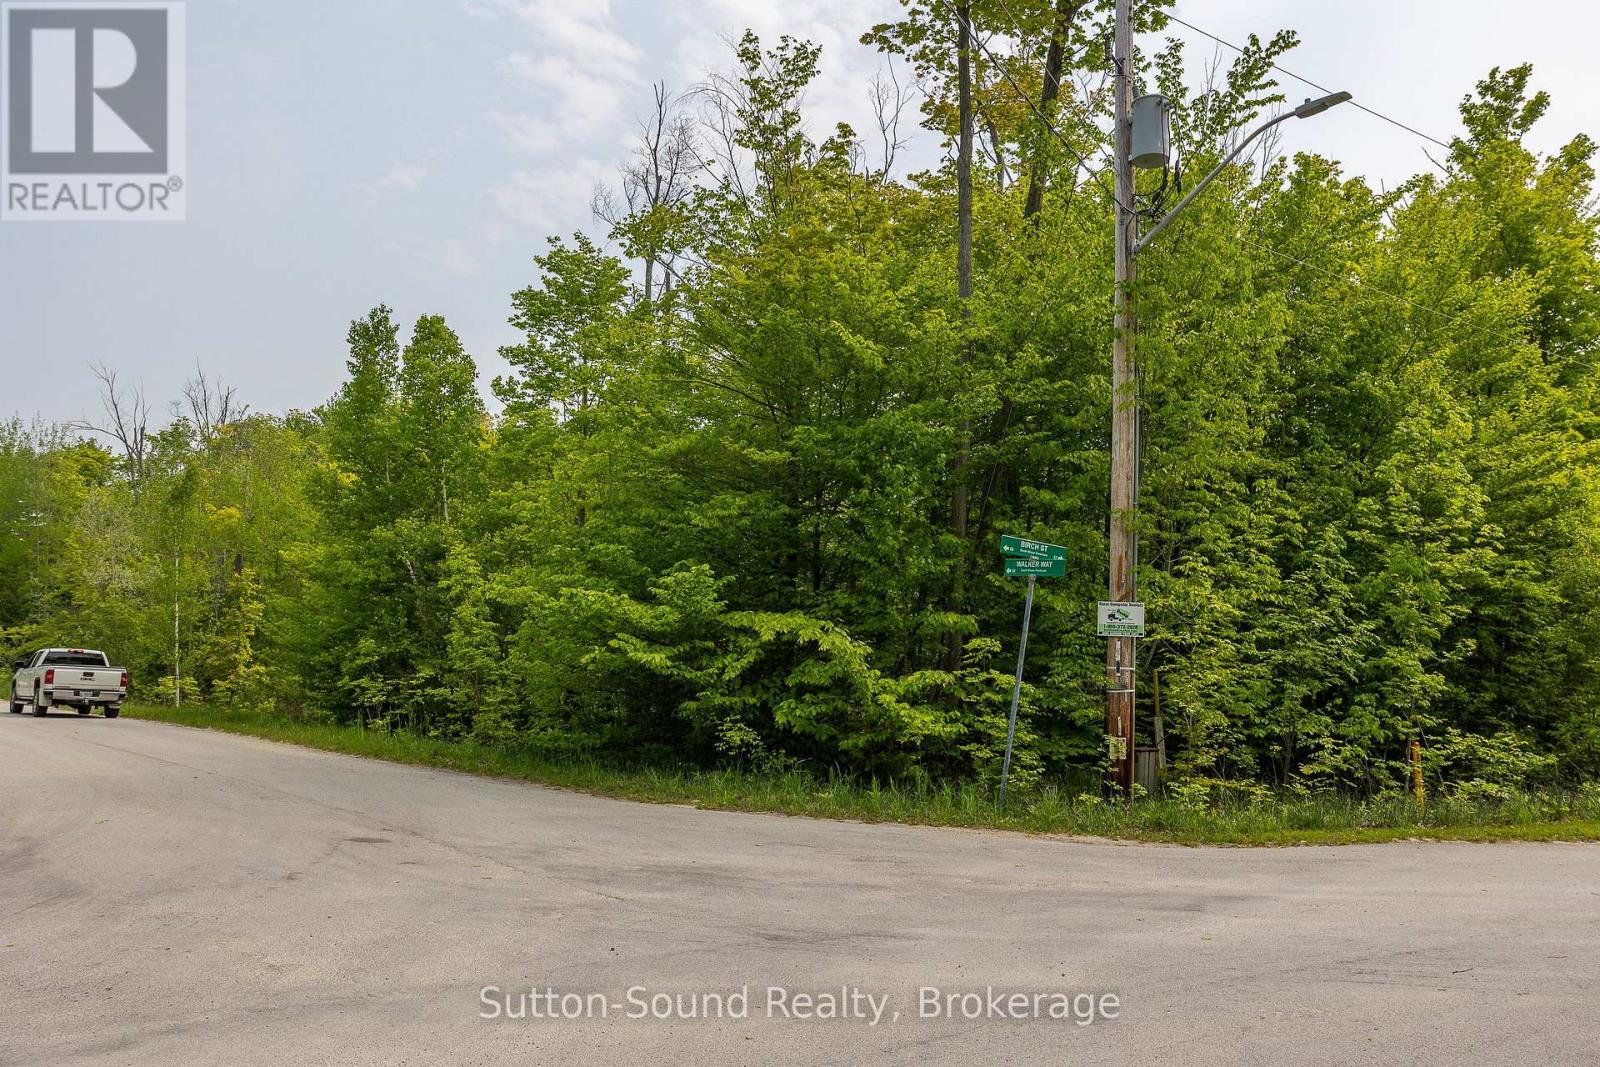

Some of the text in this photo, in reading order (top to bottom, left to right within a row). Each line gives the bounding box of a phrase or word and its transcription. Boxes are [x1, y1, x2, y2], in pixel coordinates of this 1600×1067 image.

[1020, 540, 1040, 550] BIRCH
[1040, 544, 1049, 552] ST
[1016, 560, 1054, 568] WALKER WAY
